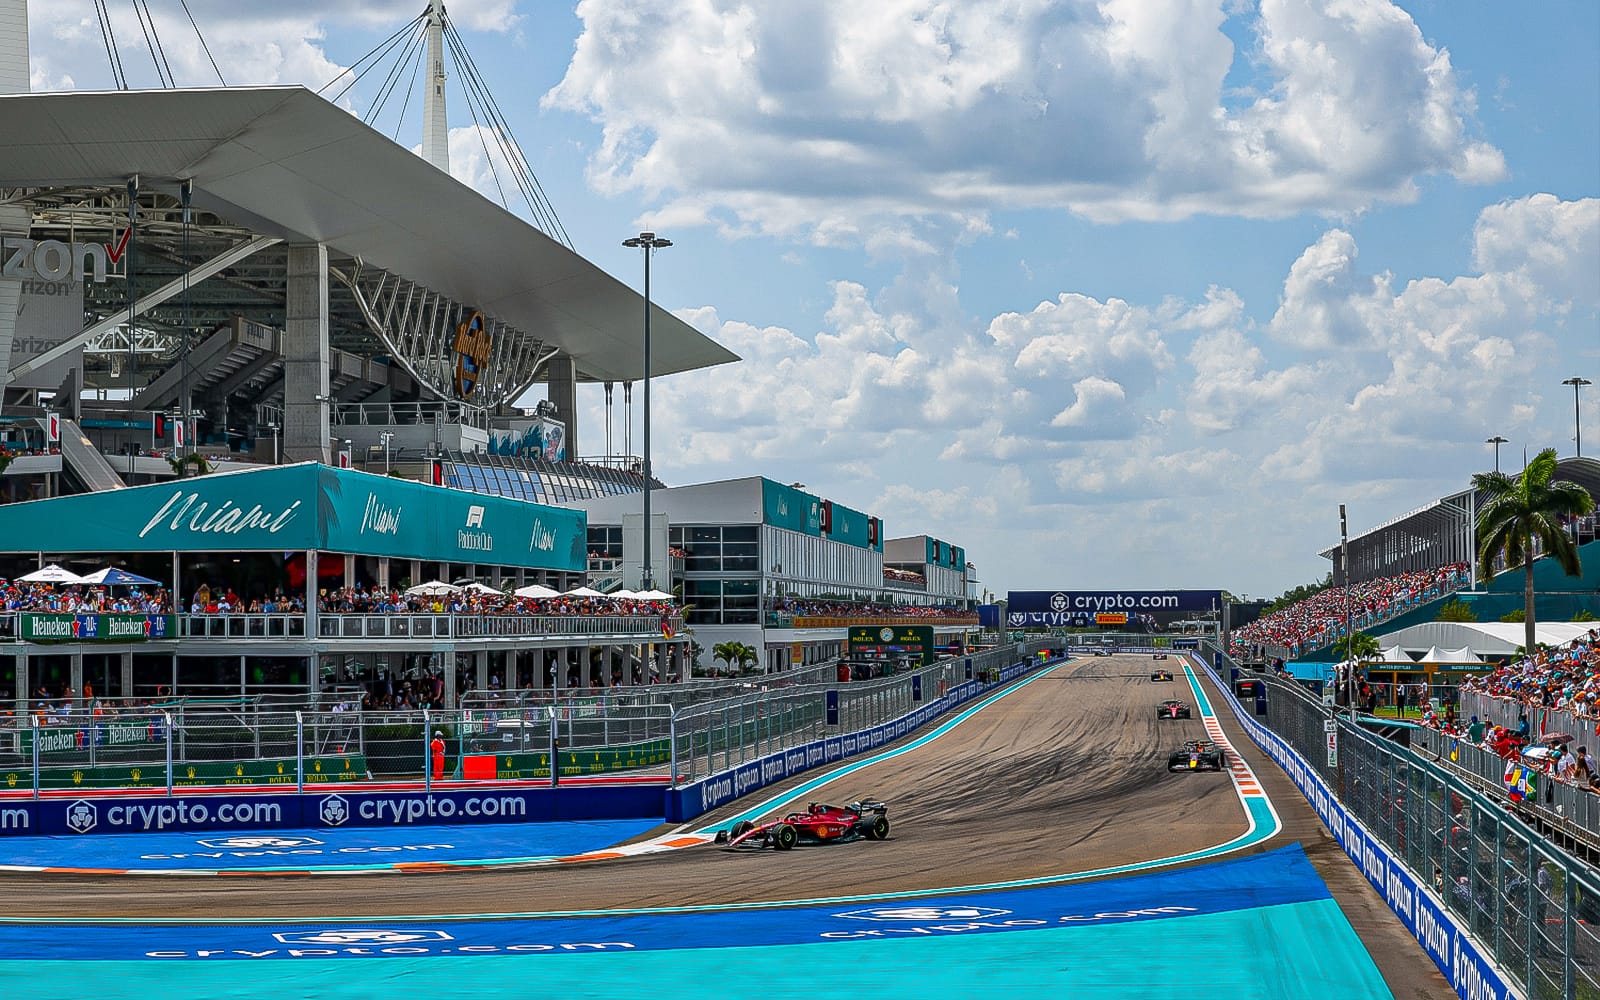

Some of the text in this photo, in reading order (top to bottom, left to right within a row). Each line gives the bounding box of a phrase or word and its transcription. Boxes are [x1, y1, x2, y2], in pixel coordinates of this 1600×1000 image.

[138, 490, 301, 538] Miami
[360, 491, 402, 535] Miami
[1075, 594, 1179, 611] crypto.com
[32, 616, 71, 637] Heineken
[109, 617, 143, 635] Heineken
[108, 723, 147, 745] Heineken
[107, 800, 281, 830] crypto.com
[359, 794, 526, 824] crypto.com
[140, 844, 456, 860] crypto.com
[144, 941, 636, 958] crypto.com
